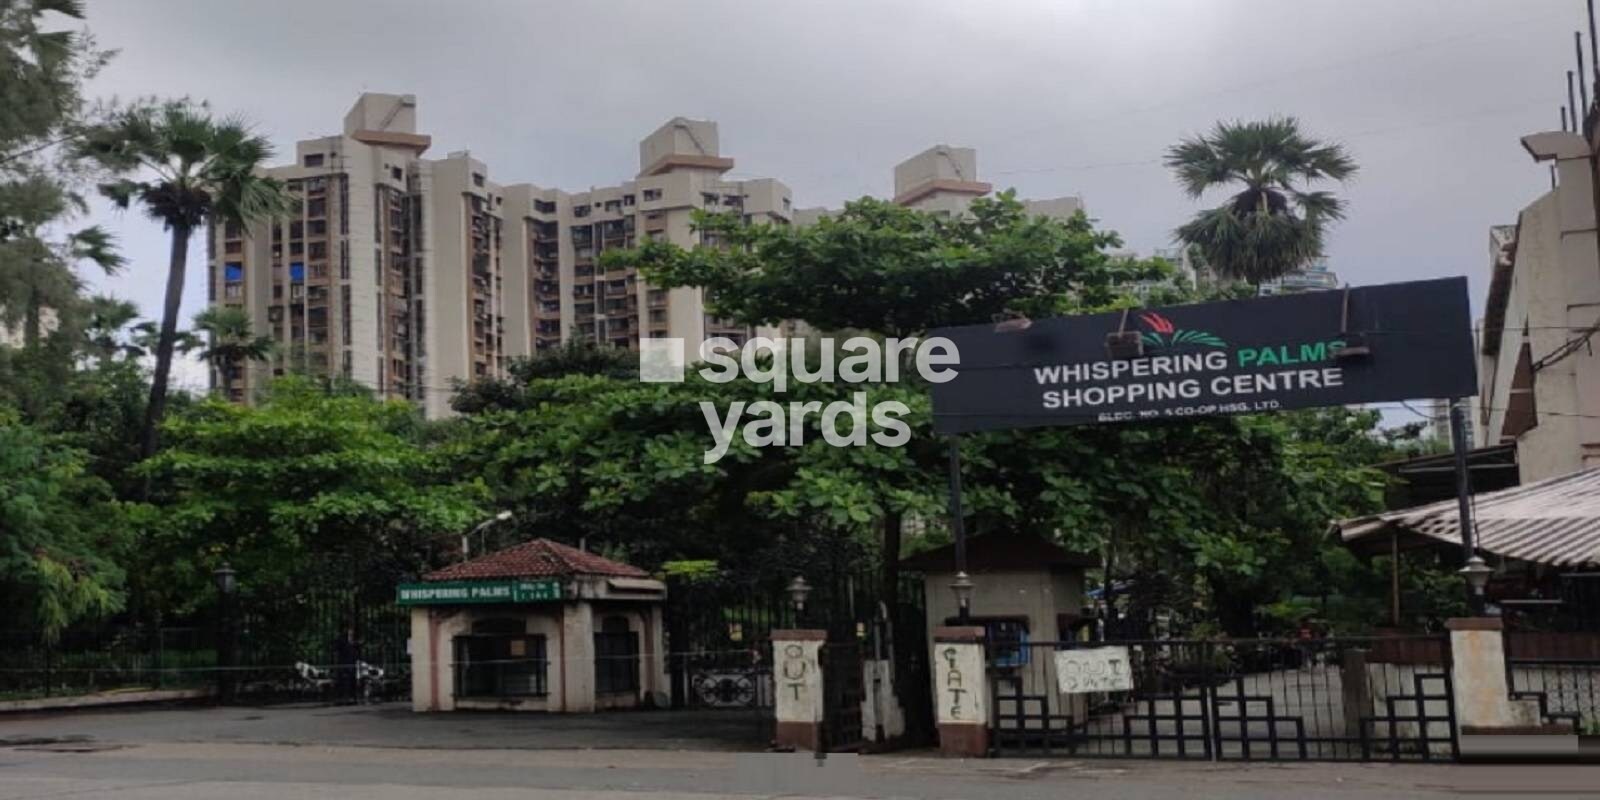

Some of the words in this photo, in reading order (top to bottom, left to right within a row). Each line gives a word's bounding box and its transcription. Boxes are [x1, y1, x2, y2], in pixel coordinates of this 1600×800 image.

[1034, 351, 1228, 385] WHISPERING
[1042, 379, 1201, 409] SHOPPING
[1210, 367, 1344, 396] CENTRE
[471, 585, 510, 599] PALMS
[783, 644, 806, 701] OUT
